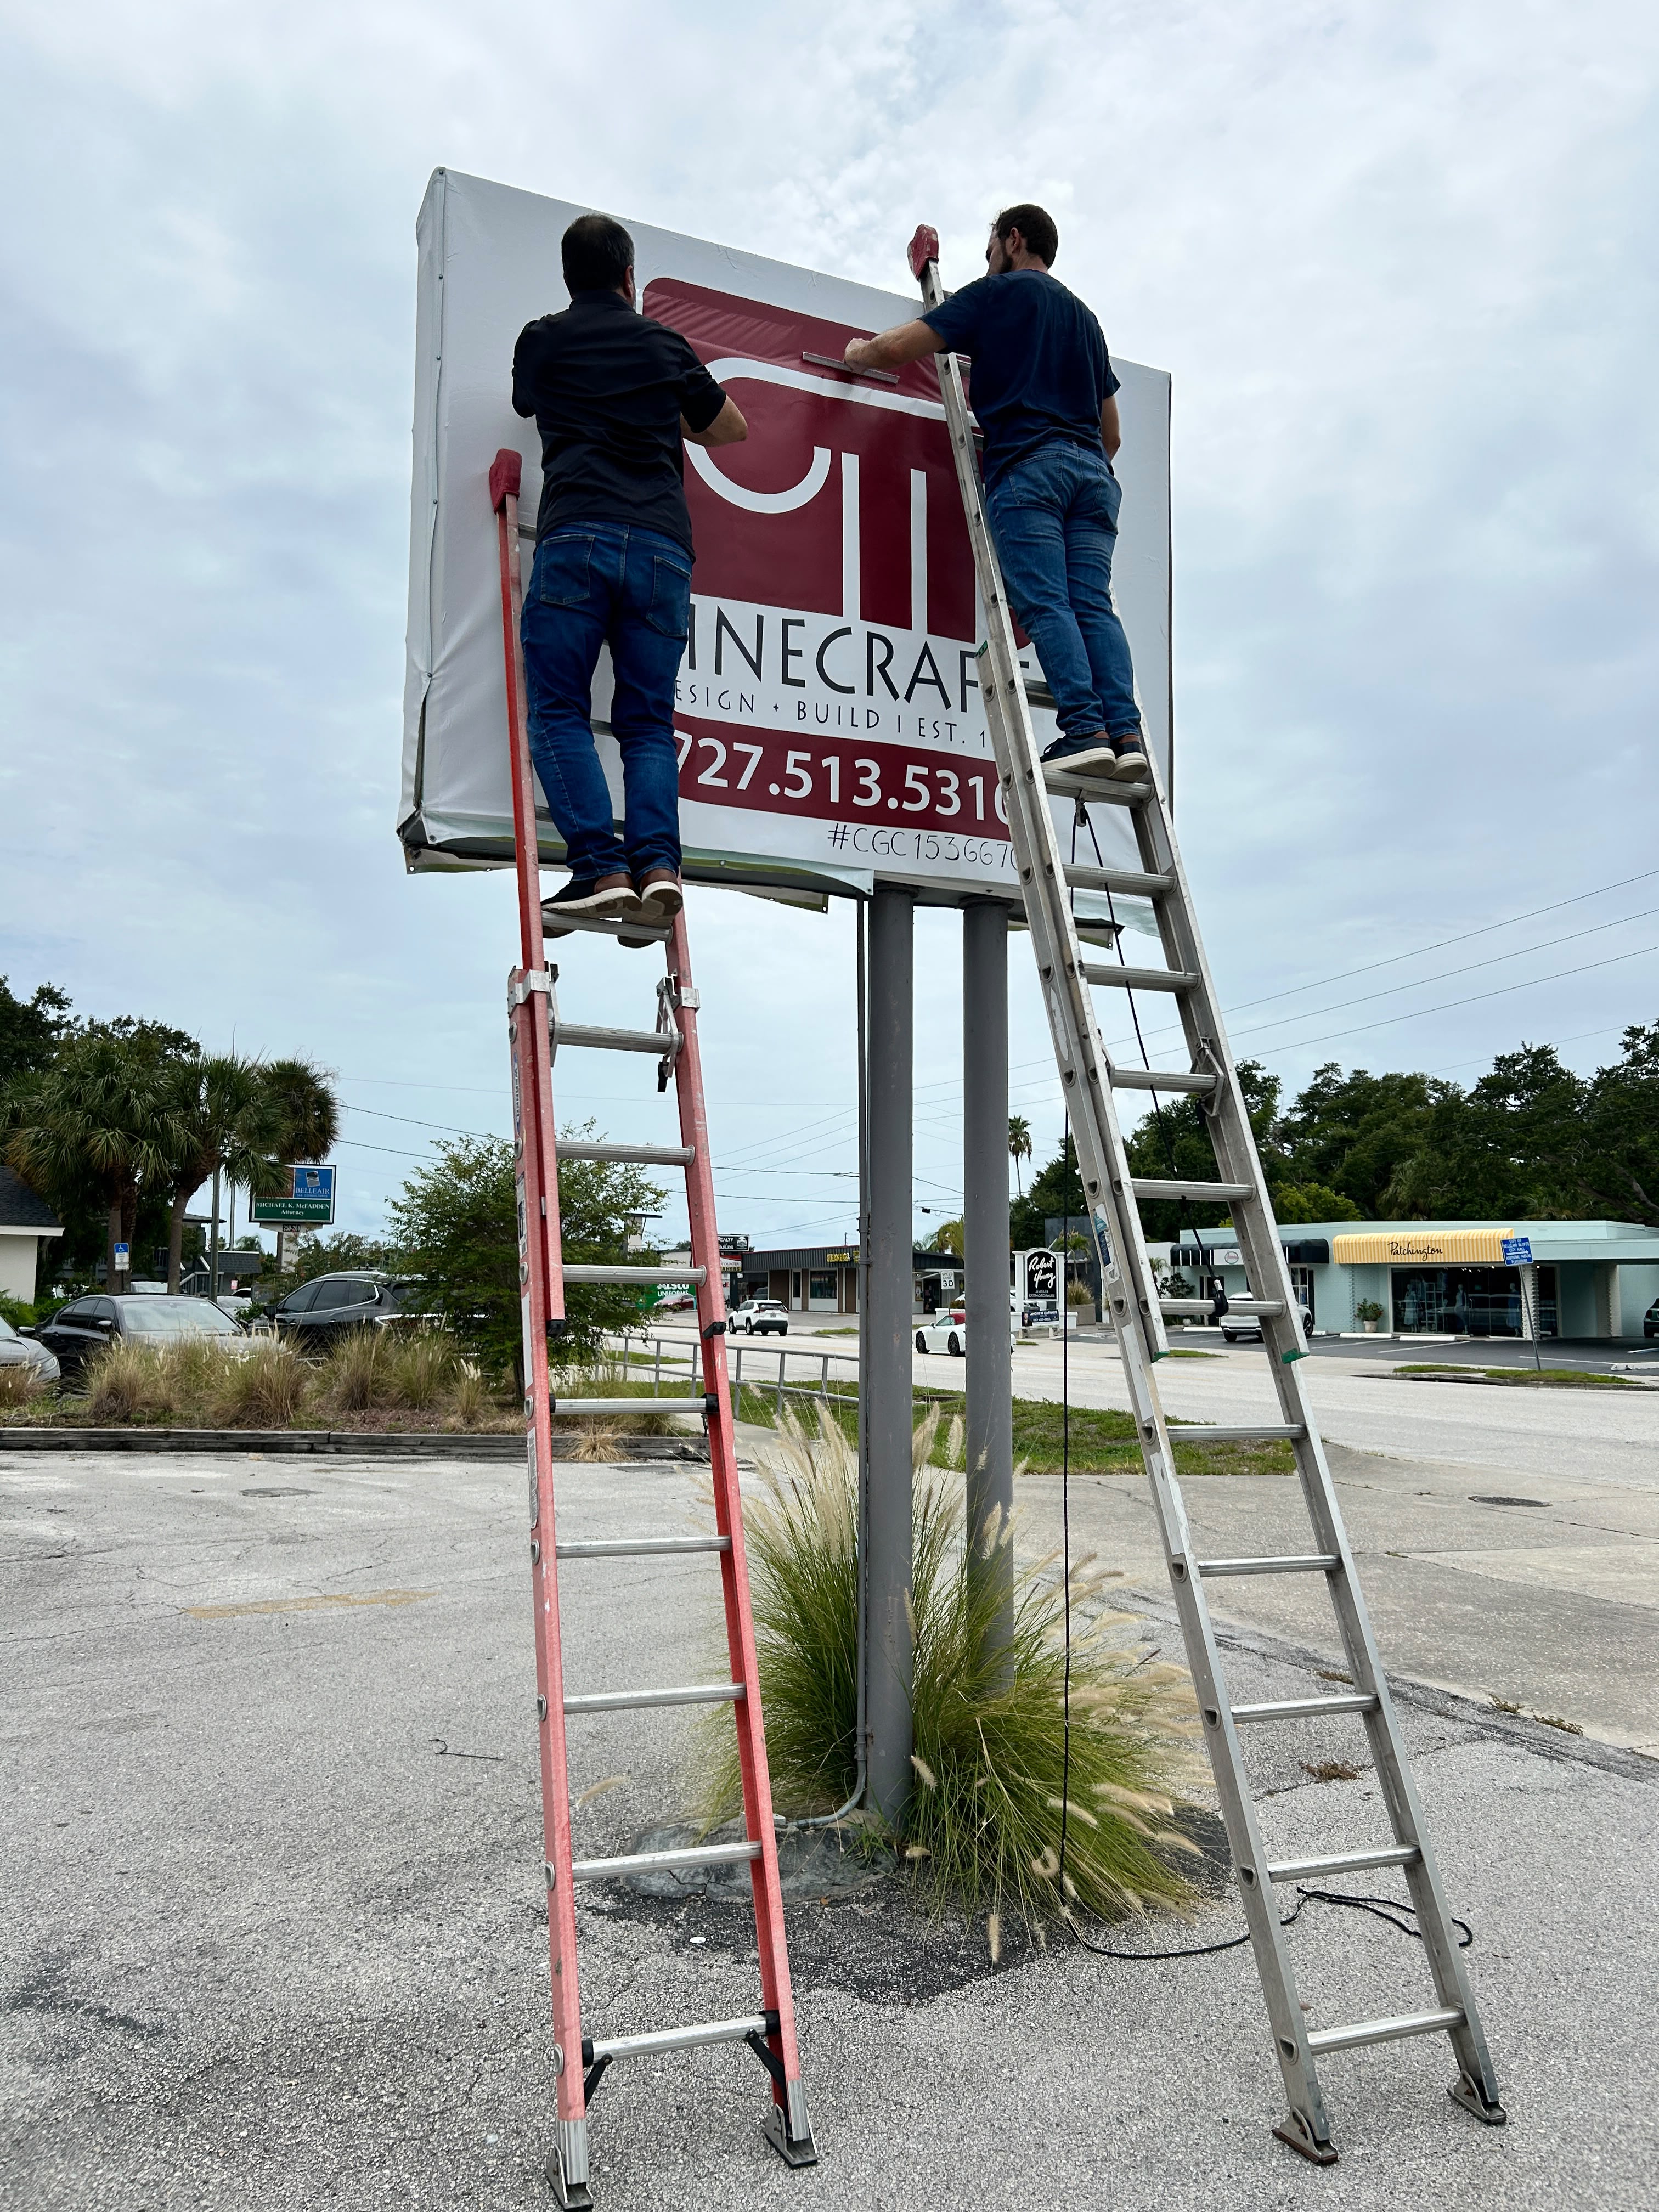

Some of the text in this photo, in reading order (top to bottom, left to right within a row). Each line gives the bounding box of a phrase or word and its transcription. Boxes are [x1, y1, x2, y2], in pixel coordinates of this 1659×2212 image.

[689, 603, 1029, 713] INECRAF
[675, 680, 754, 713] ESIGN
[798, 701, 879, 729] BUILD
[918, 718, 965, 744] EST.
[1387, 1241, 1444, 1262] Patchington
[1028, 1256, 1055, 1271] Robert
[1034, 1269, 1056, 1289] Young
